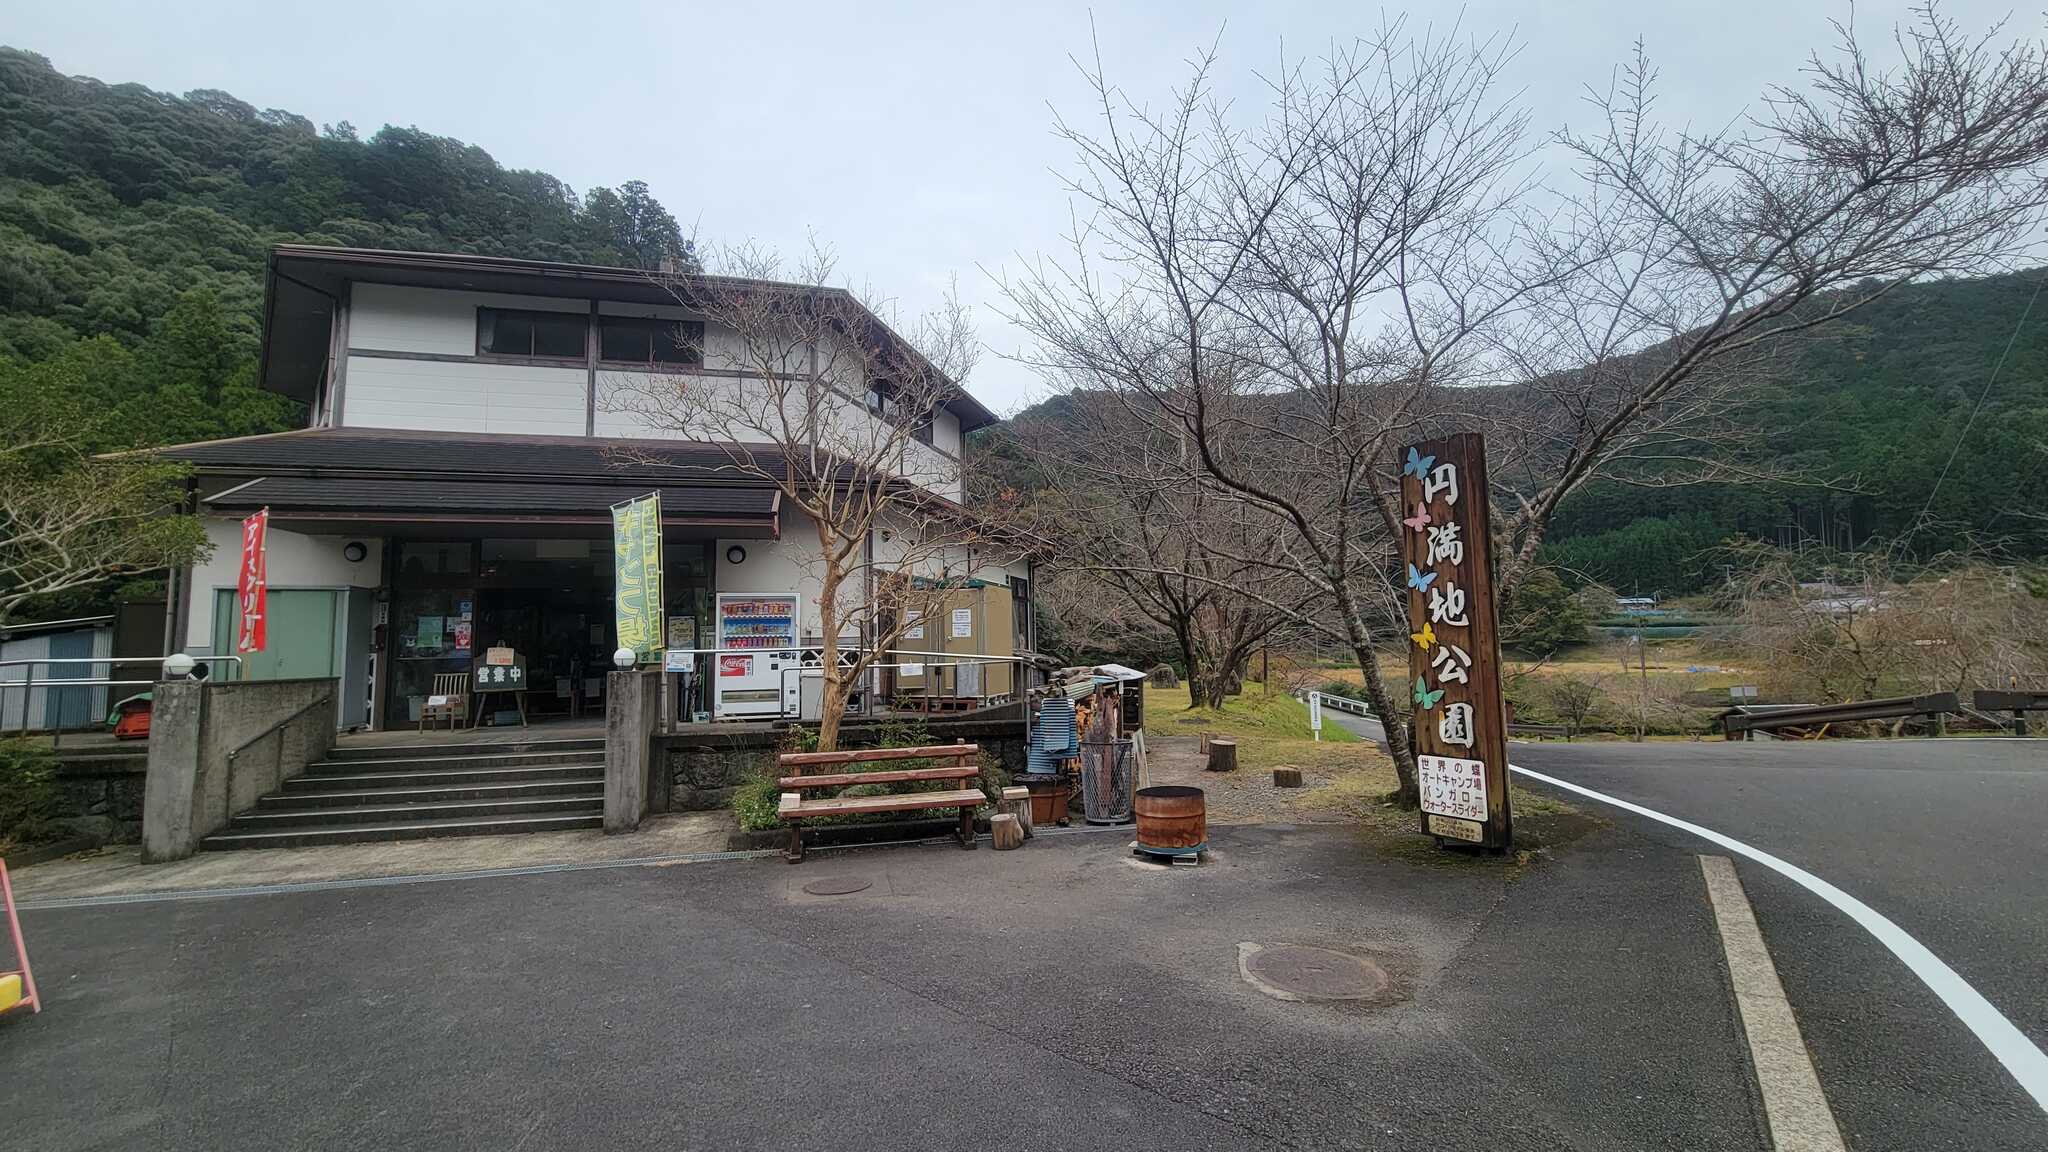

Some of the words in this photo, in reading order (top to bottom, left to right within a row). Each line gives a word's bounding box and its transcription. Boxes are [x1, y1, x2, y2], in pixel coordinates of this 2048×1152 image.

[241, 524, 258, 648] アイスクリーム
[1424, 463, 1473, 749] 円満地公園
[477, 666, 521, 682] 営業中
[1422, 758, 1480, 776] 世界の蝶
[1423, 773, 1481, 790] オートキャンプ場
[1424, 785, 1482, 803] バンガロー
[1424, 800, 1483, 817] ウォータースライダー
